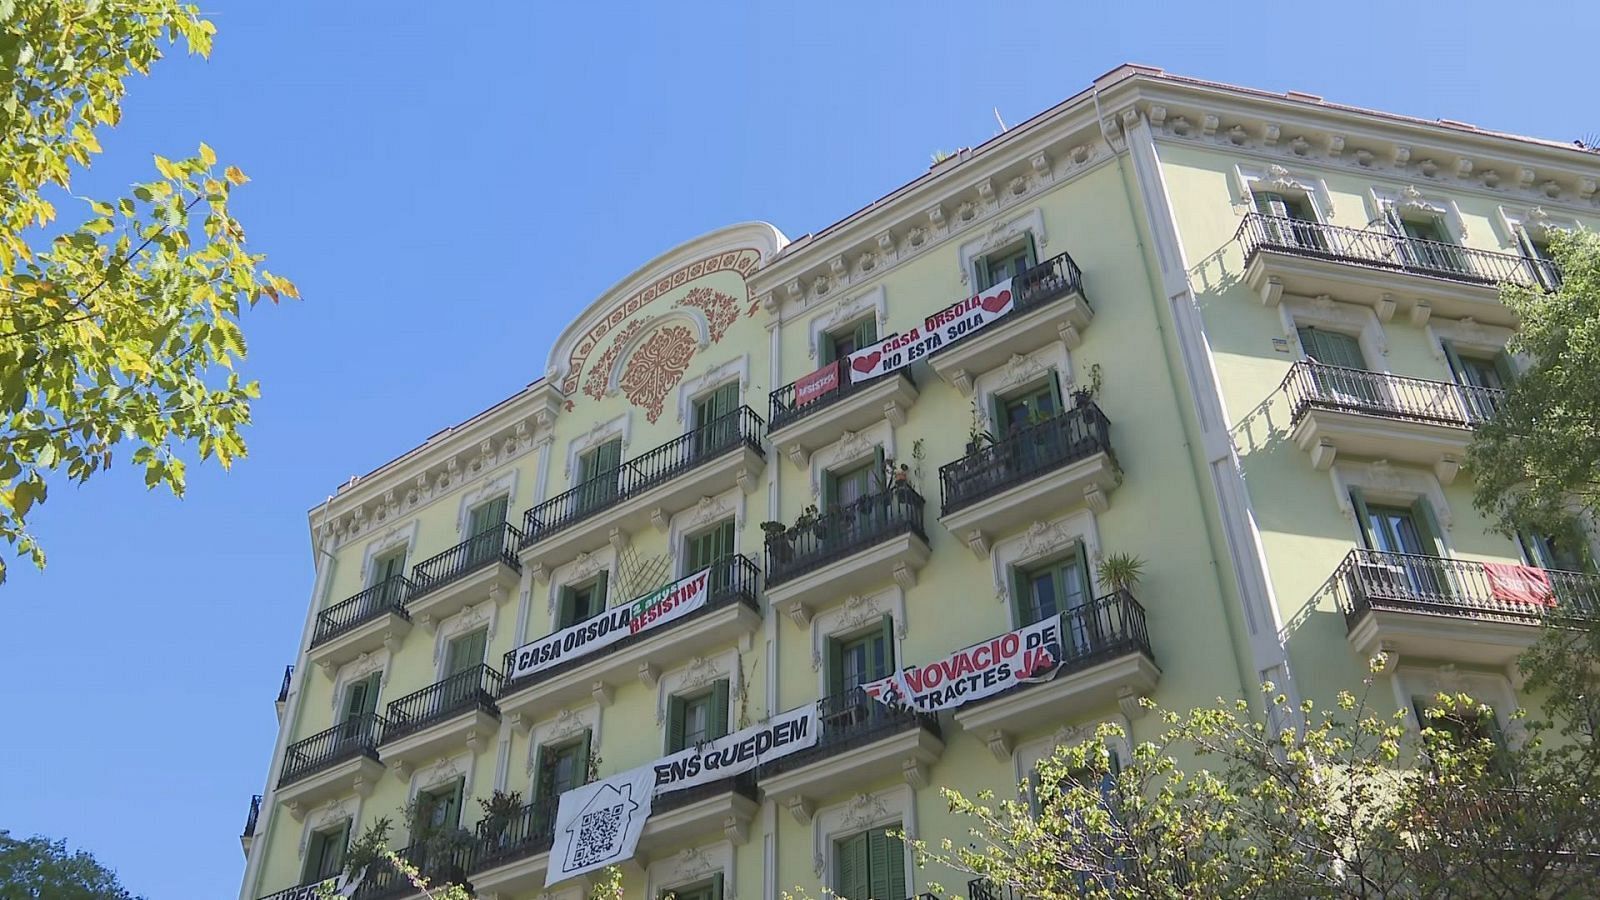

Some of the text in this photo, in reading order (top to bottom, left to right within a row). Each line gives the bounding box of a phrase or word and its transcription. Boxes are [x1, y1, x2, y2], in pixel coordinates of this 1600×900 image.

[881, 294, 981, 354] CASA ORSOLA
[882, 352, 902, 371] NO
[947, 313, 984, 340] SOLA
[629, 573, 708, 634] RESISTINT
[518, 610, 630, 672] CASA ORSOLA
[1026, 625, 1056, 650] DE
[654, 715, 808, 786] ENS QUEDEM
